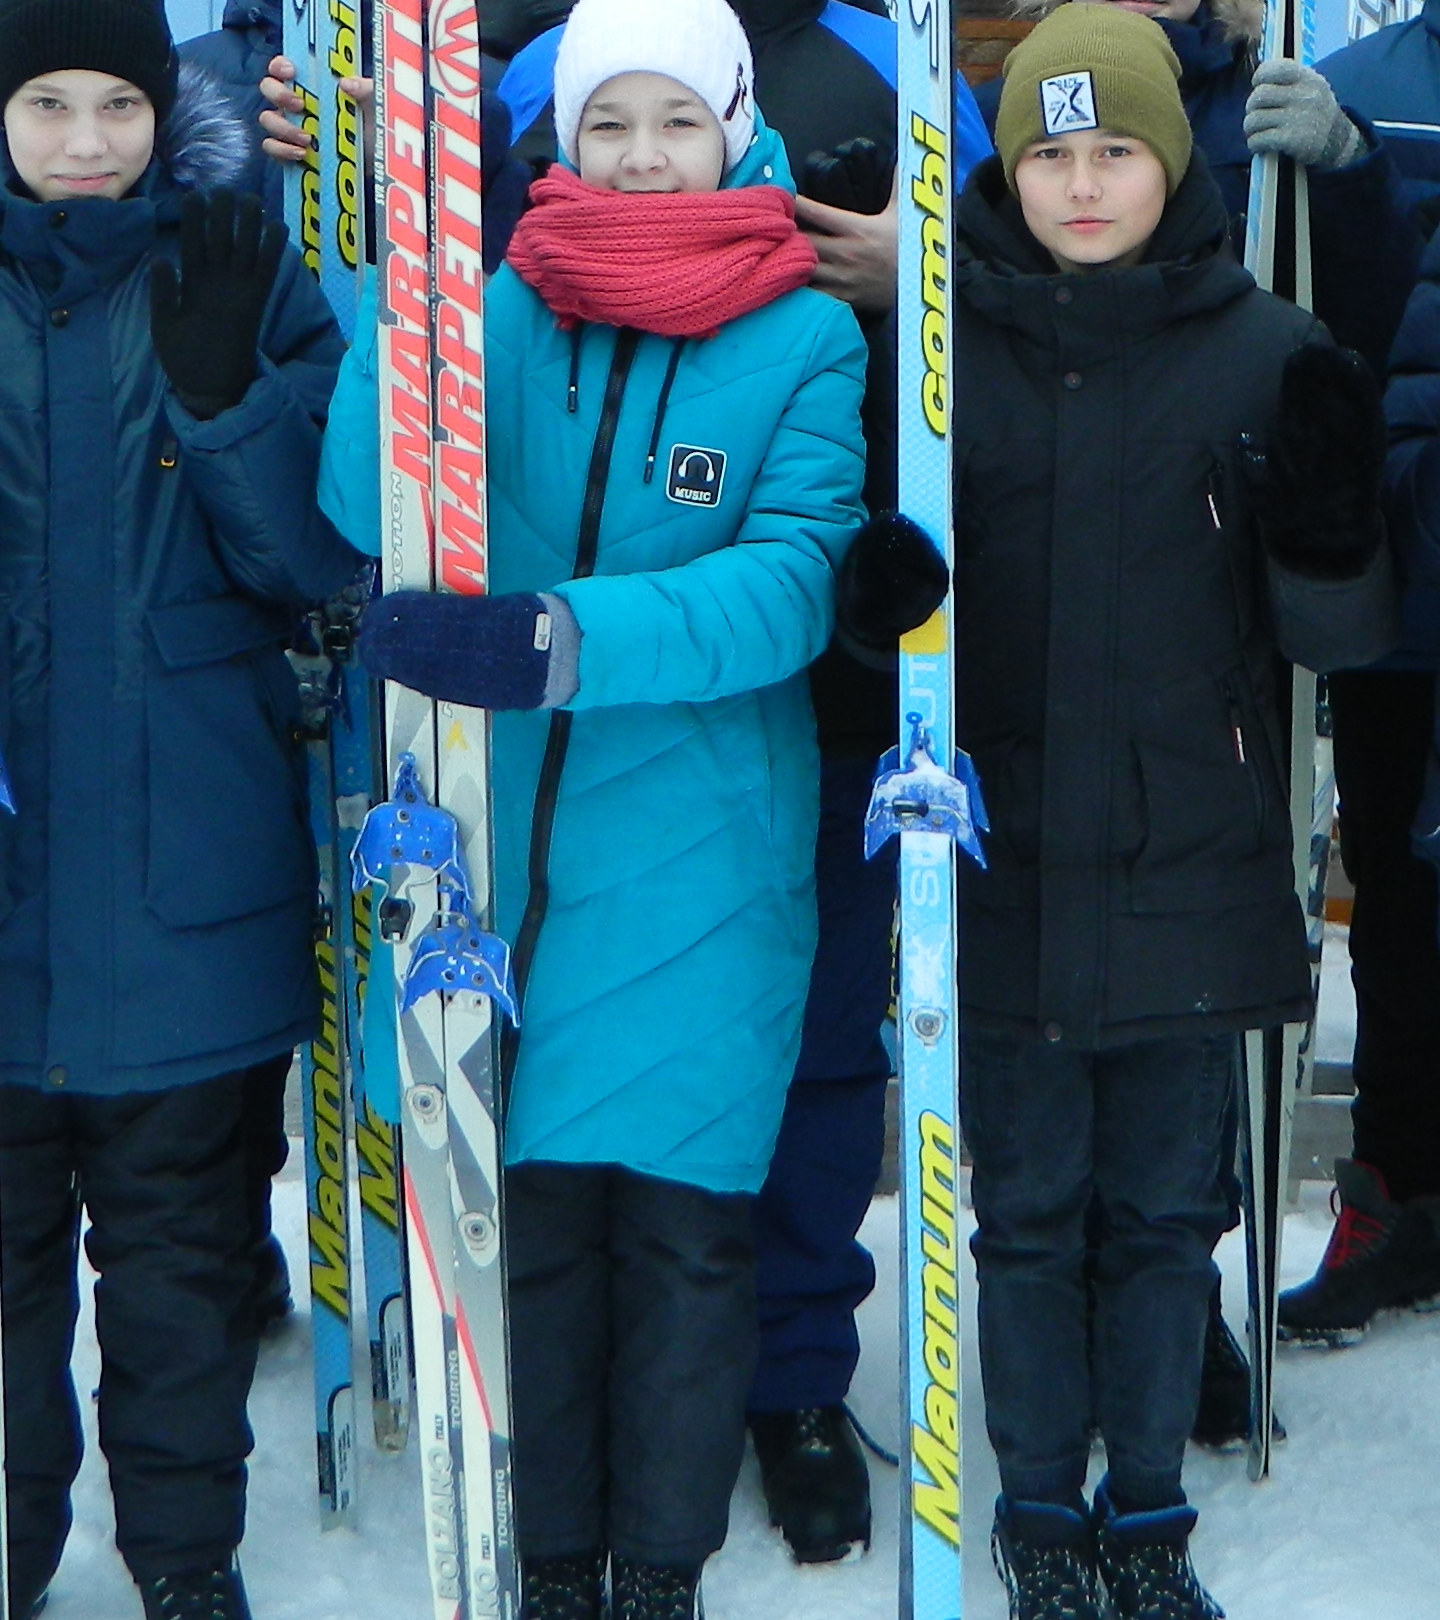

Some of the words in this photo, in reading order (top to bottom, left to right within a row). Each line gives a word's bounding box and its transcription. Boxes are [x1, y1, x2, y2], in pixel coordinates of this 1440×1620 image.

[372, 0, 387, 60] technology
[374, 61, 386, 104] express
[374, 105, 386, 126] pro
[374, 128, 385, 161] future
[374, 161, 385, 183] 460
[374, 183, 385, 206] SVR
[911, 110, 948, 440] combi
[434, 93, 485, 595] MARPETTI
[675, 487, 712, 502] MUSIC
[447, 1350, 462, 1429] TOURING
[434, 1414, 445, 1441] ITALY
[428, 1446, 461, 1602] BOLZANO
[494, 1468, 509, 1548] TOURING
[480, 1533, 491, 1561] ITALY
